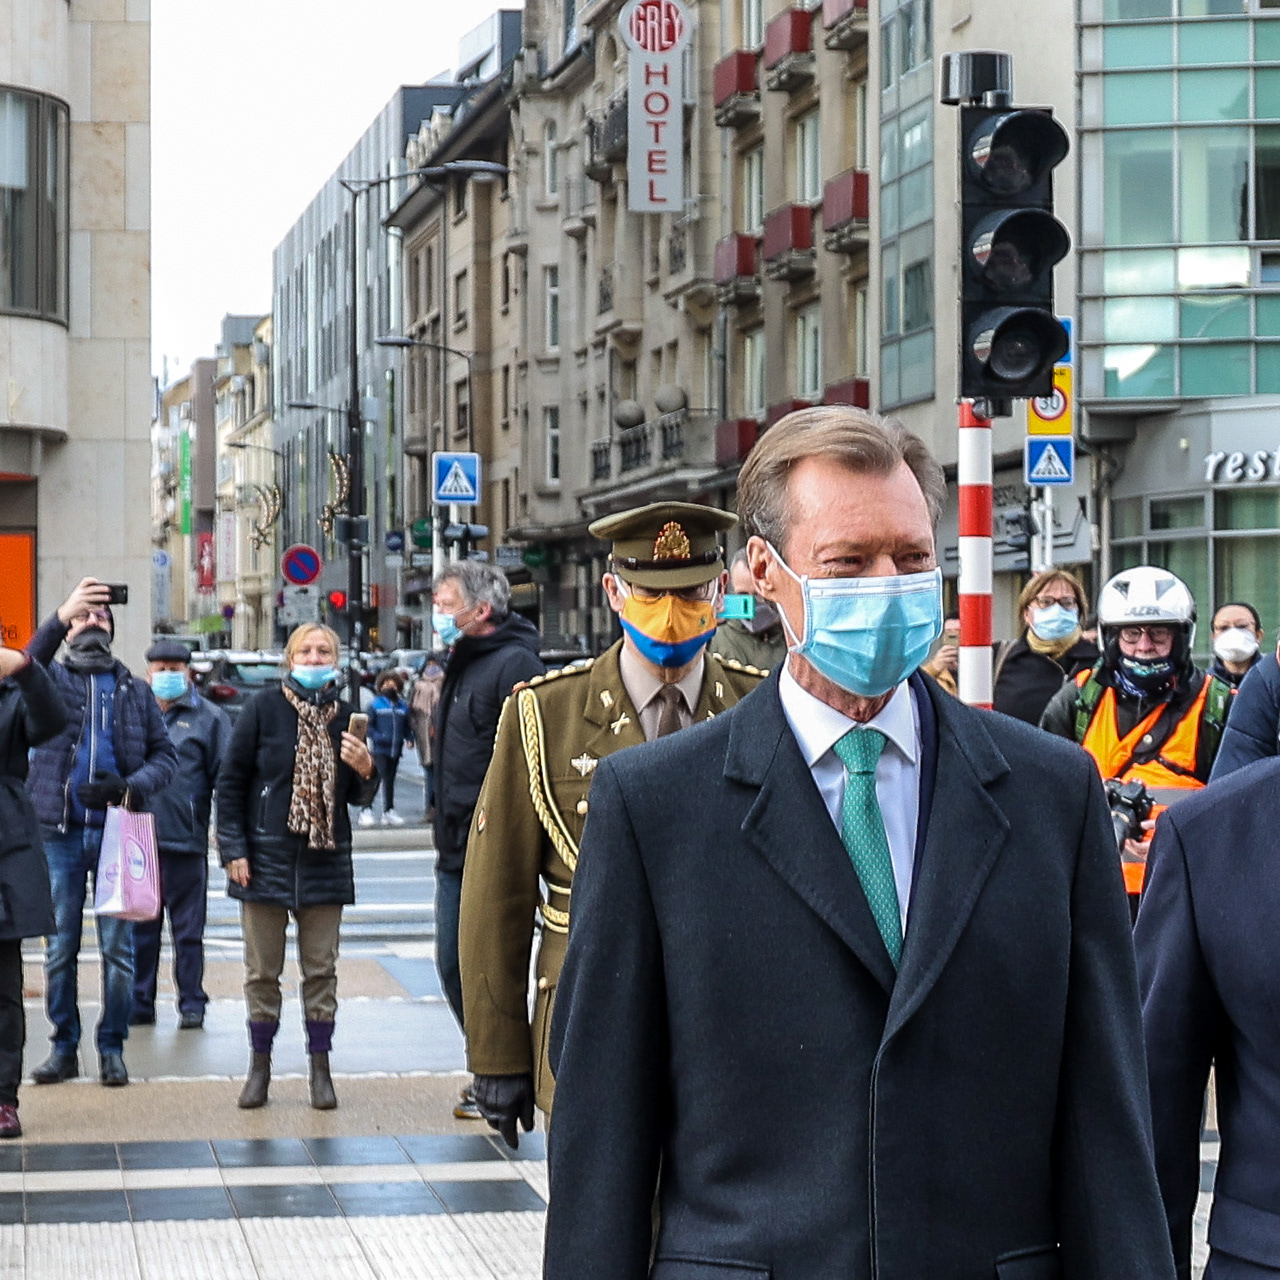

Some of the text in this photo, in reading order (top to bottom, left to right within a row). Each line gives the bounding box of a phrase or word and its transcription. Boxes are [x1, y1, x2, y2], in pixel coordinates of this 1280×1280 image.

[631, 0, 683, 52] GREY
[643, 62, 671, 204] HOTEL
[1039, 394, 1061, 411] 30
